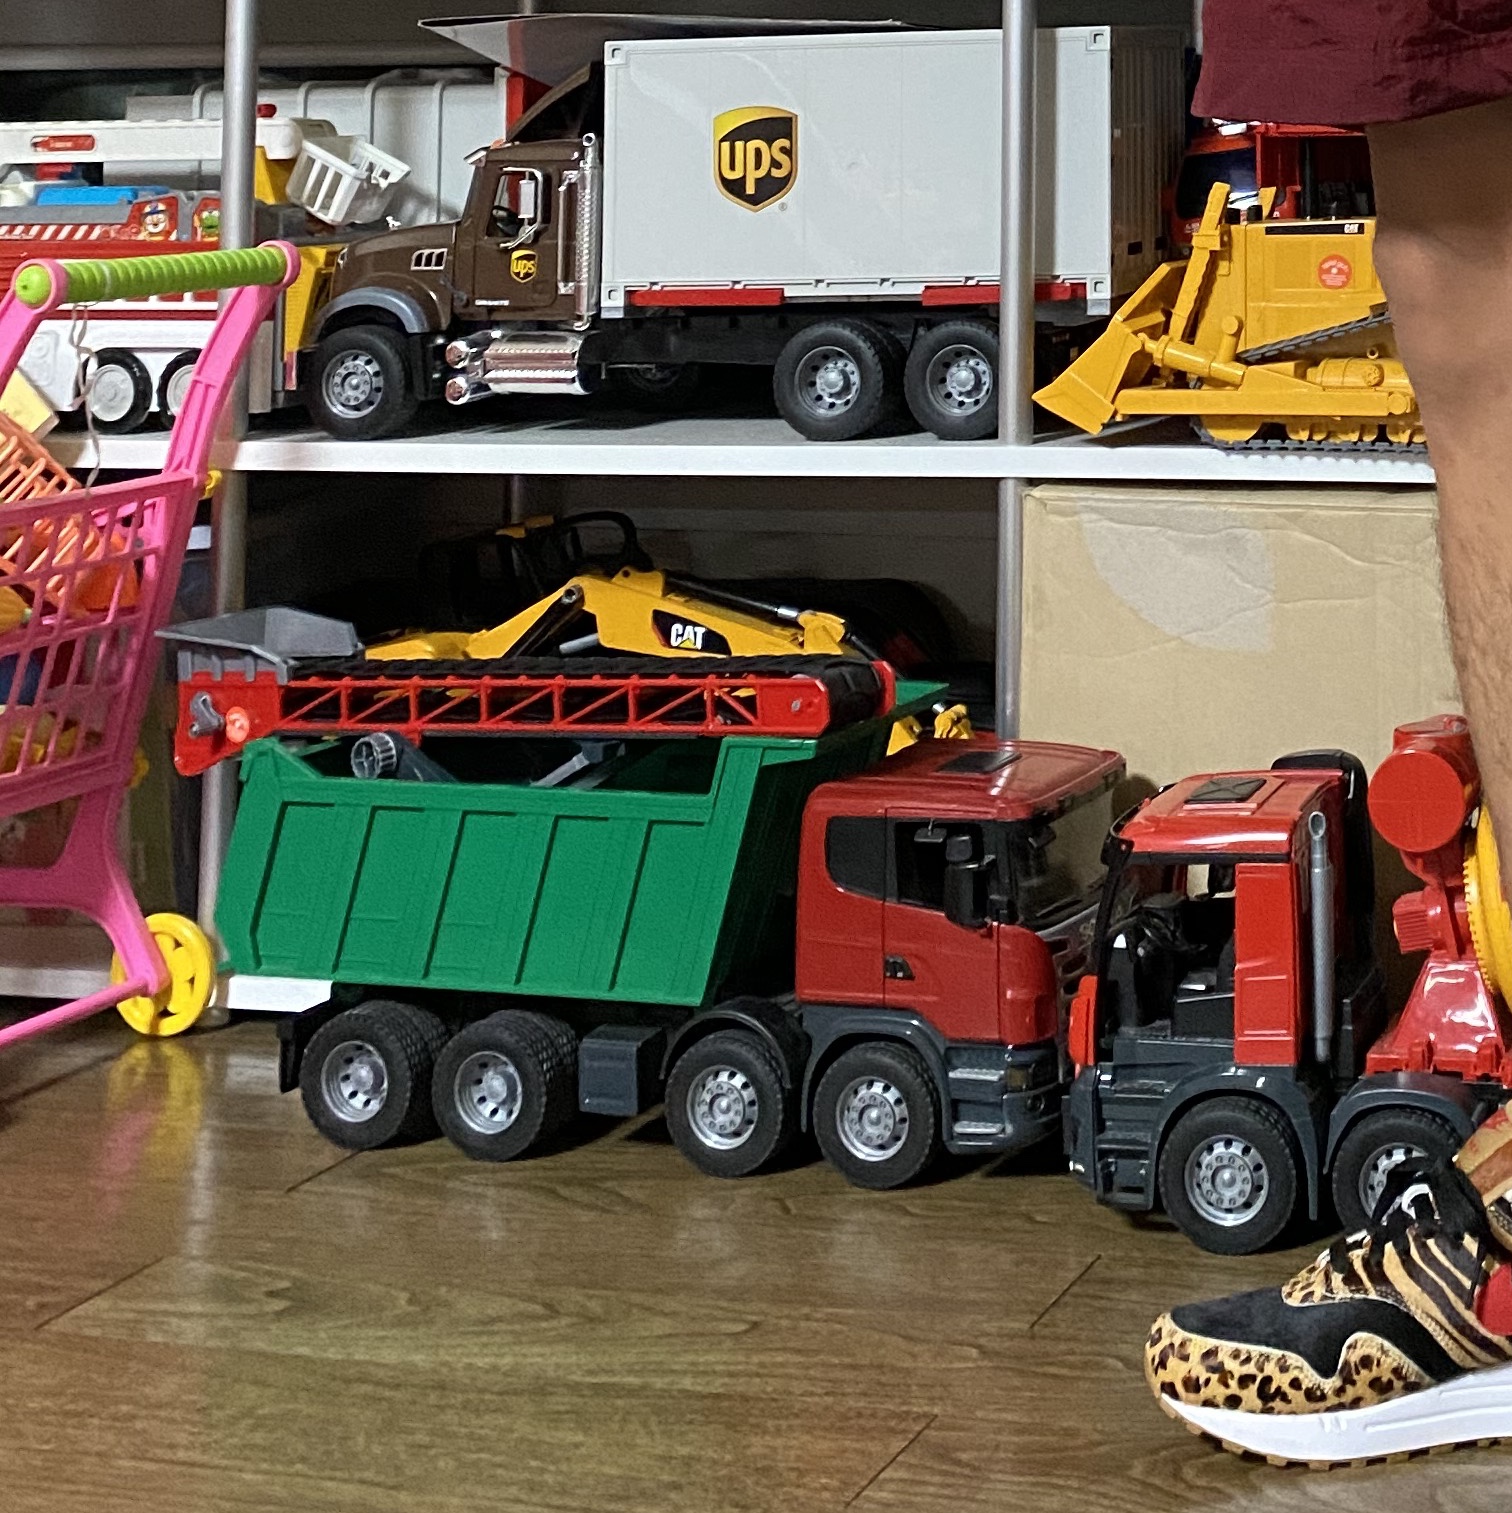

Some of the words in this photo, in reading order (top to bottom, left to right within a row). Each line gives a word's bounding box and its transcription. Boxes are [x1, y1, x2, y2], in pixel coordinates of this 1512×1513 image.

[720, 137, 792, 195] ups
[511, 259, 535, 278] ups
[670, 623, 706, 650] CAT
